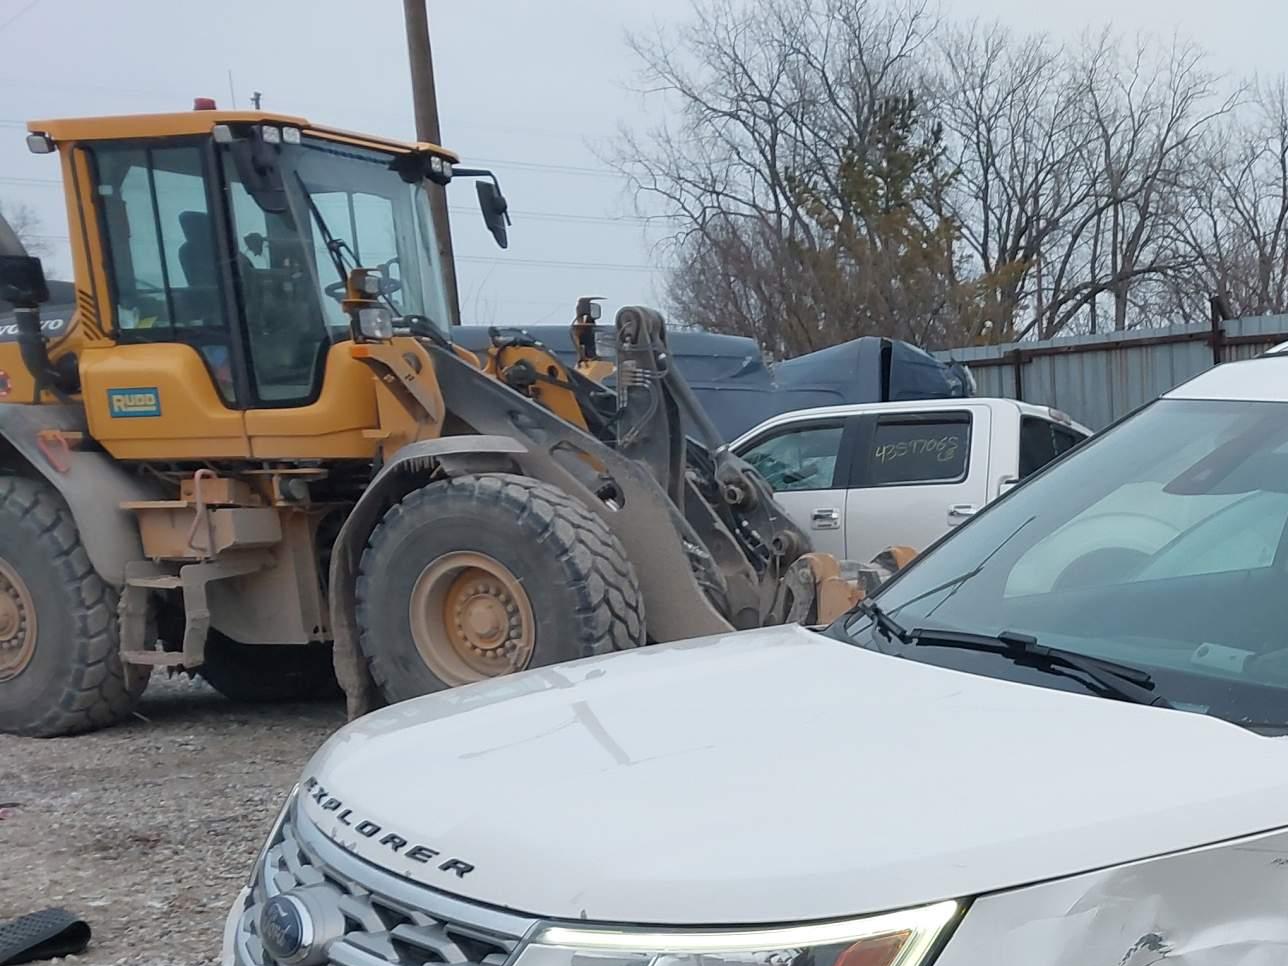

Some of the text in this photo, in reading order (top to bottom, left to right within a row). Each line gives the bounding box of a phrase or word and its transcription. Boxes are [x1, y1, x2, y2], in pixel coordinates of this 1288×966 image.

[0, 318, 64, 336] VOVO
[112, 393, 157, 412] RUDD
[304, 775, 478, 880] EXPLORER
